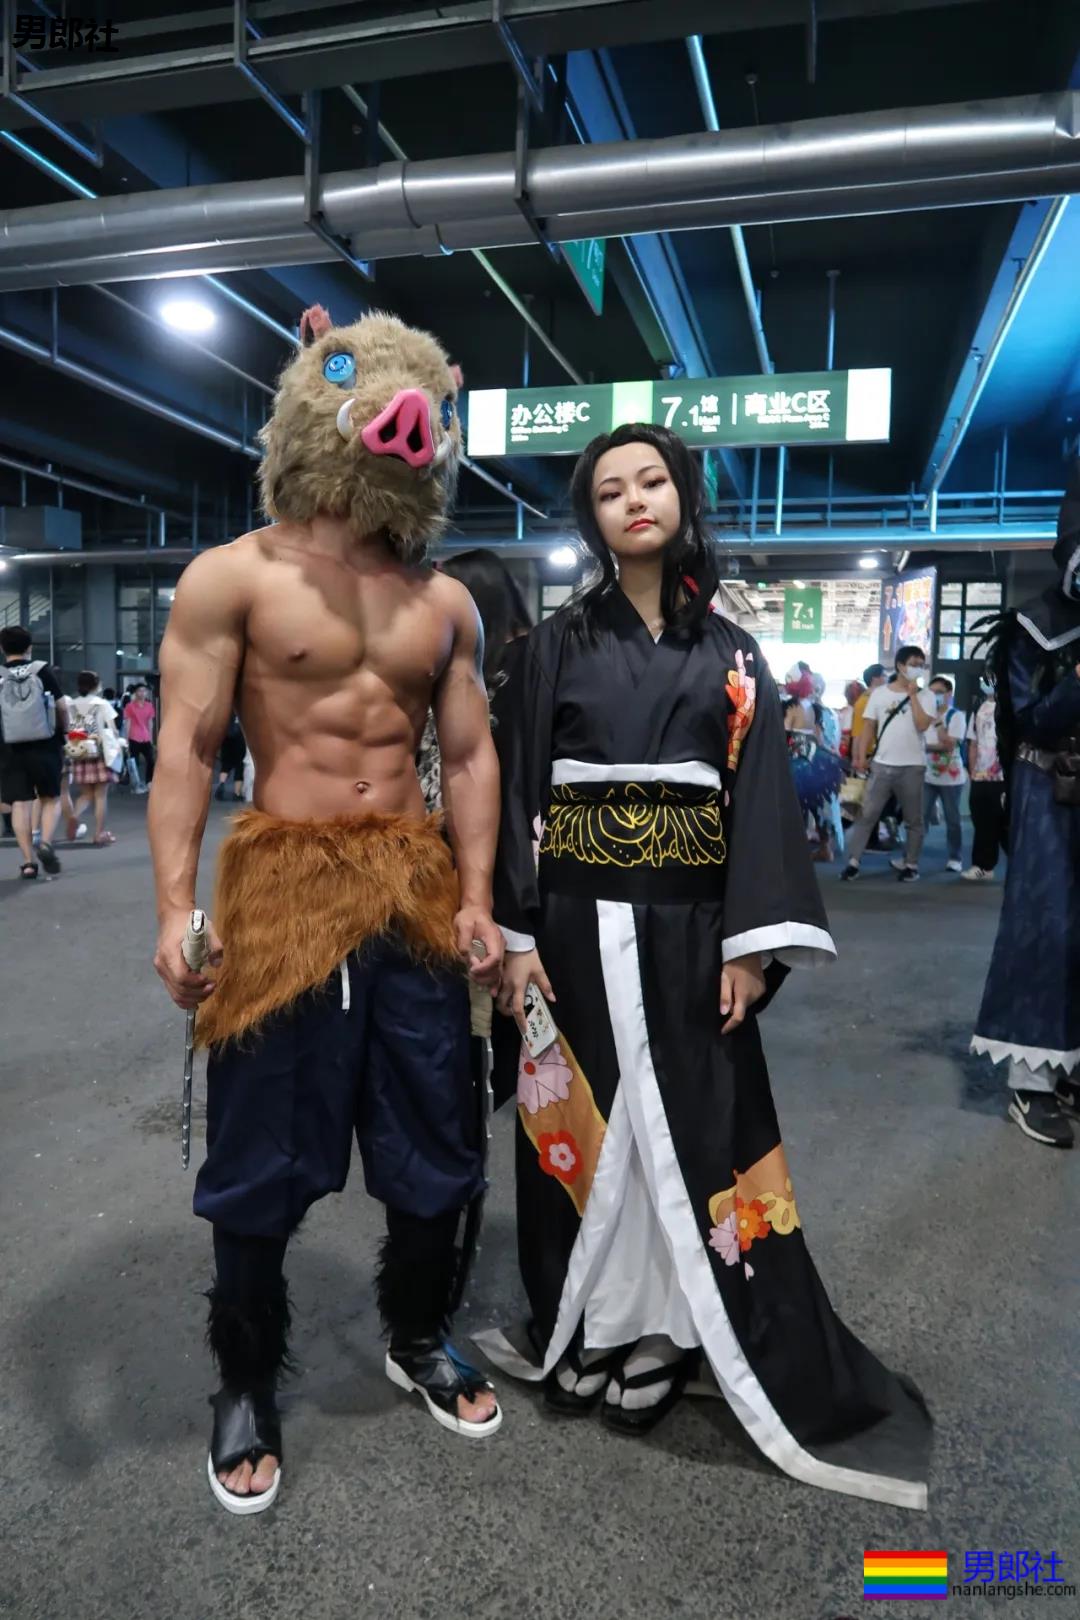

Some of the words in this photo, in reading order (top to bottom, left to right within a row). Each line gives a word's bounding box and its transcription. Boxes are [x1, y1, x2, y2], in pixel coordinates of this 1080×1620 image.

[511, 401, 591, 426] 办公楼C
[661, 396, 699, 428] 7.1
[792, 602, 814, 619] 7.1
